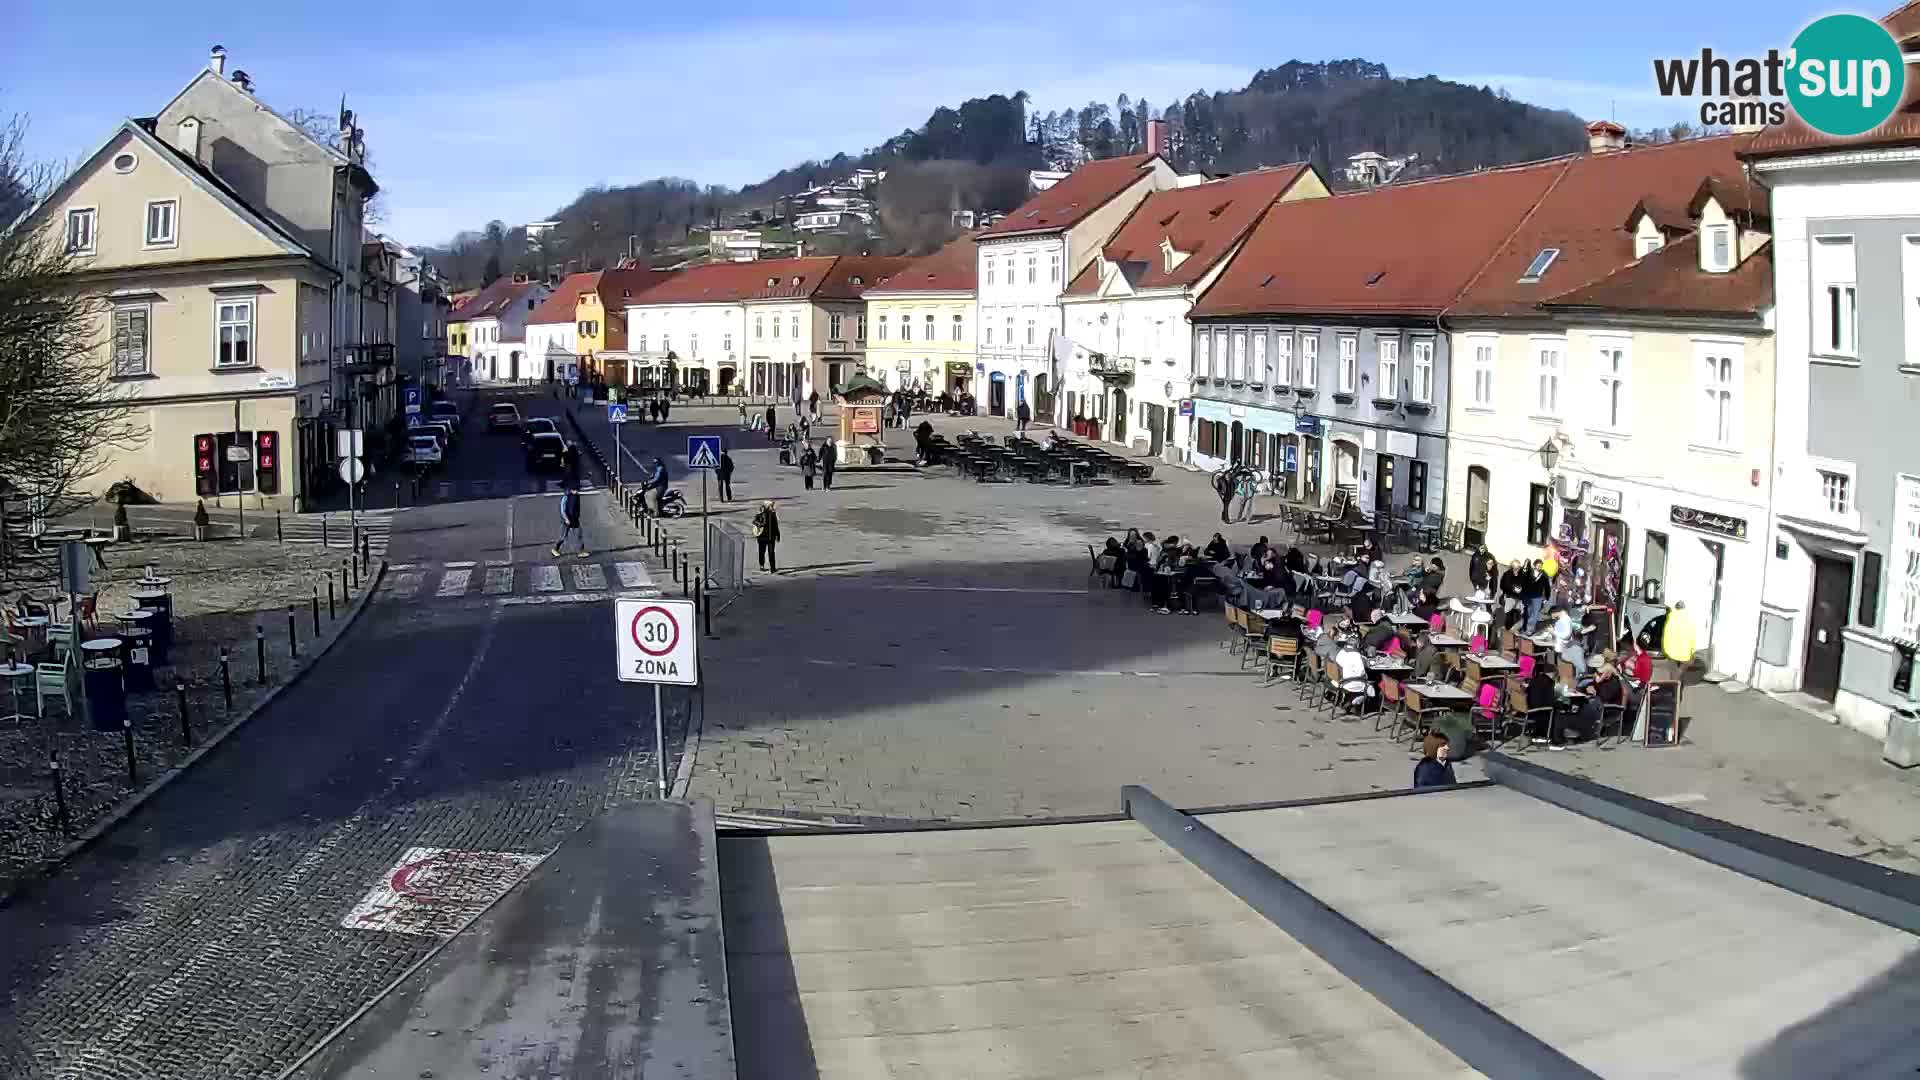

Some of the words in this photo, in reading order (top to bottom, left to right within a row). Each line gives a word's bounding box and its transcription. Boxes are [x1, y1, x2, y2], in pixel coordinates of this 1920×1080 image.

[409, 391, 416, 402] P
[644, 622, 668, 643] 30
[634, 659, 678, 676] ZONA
